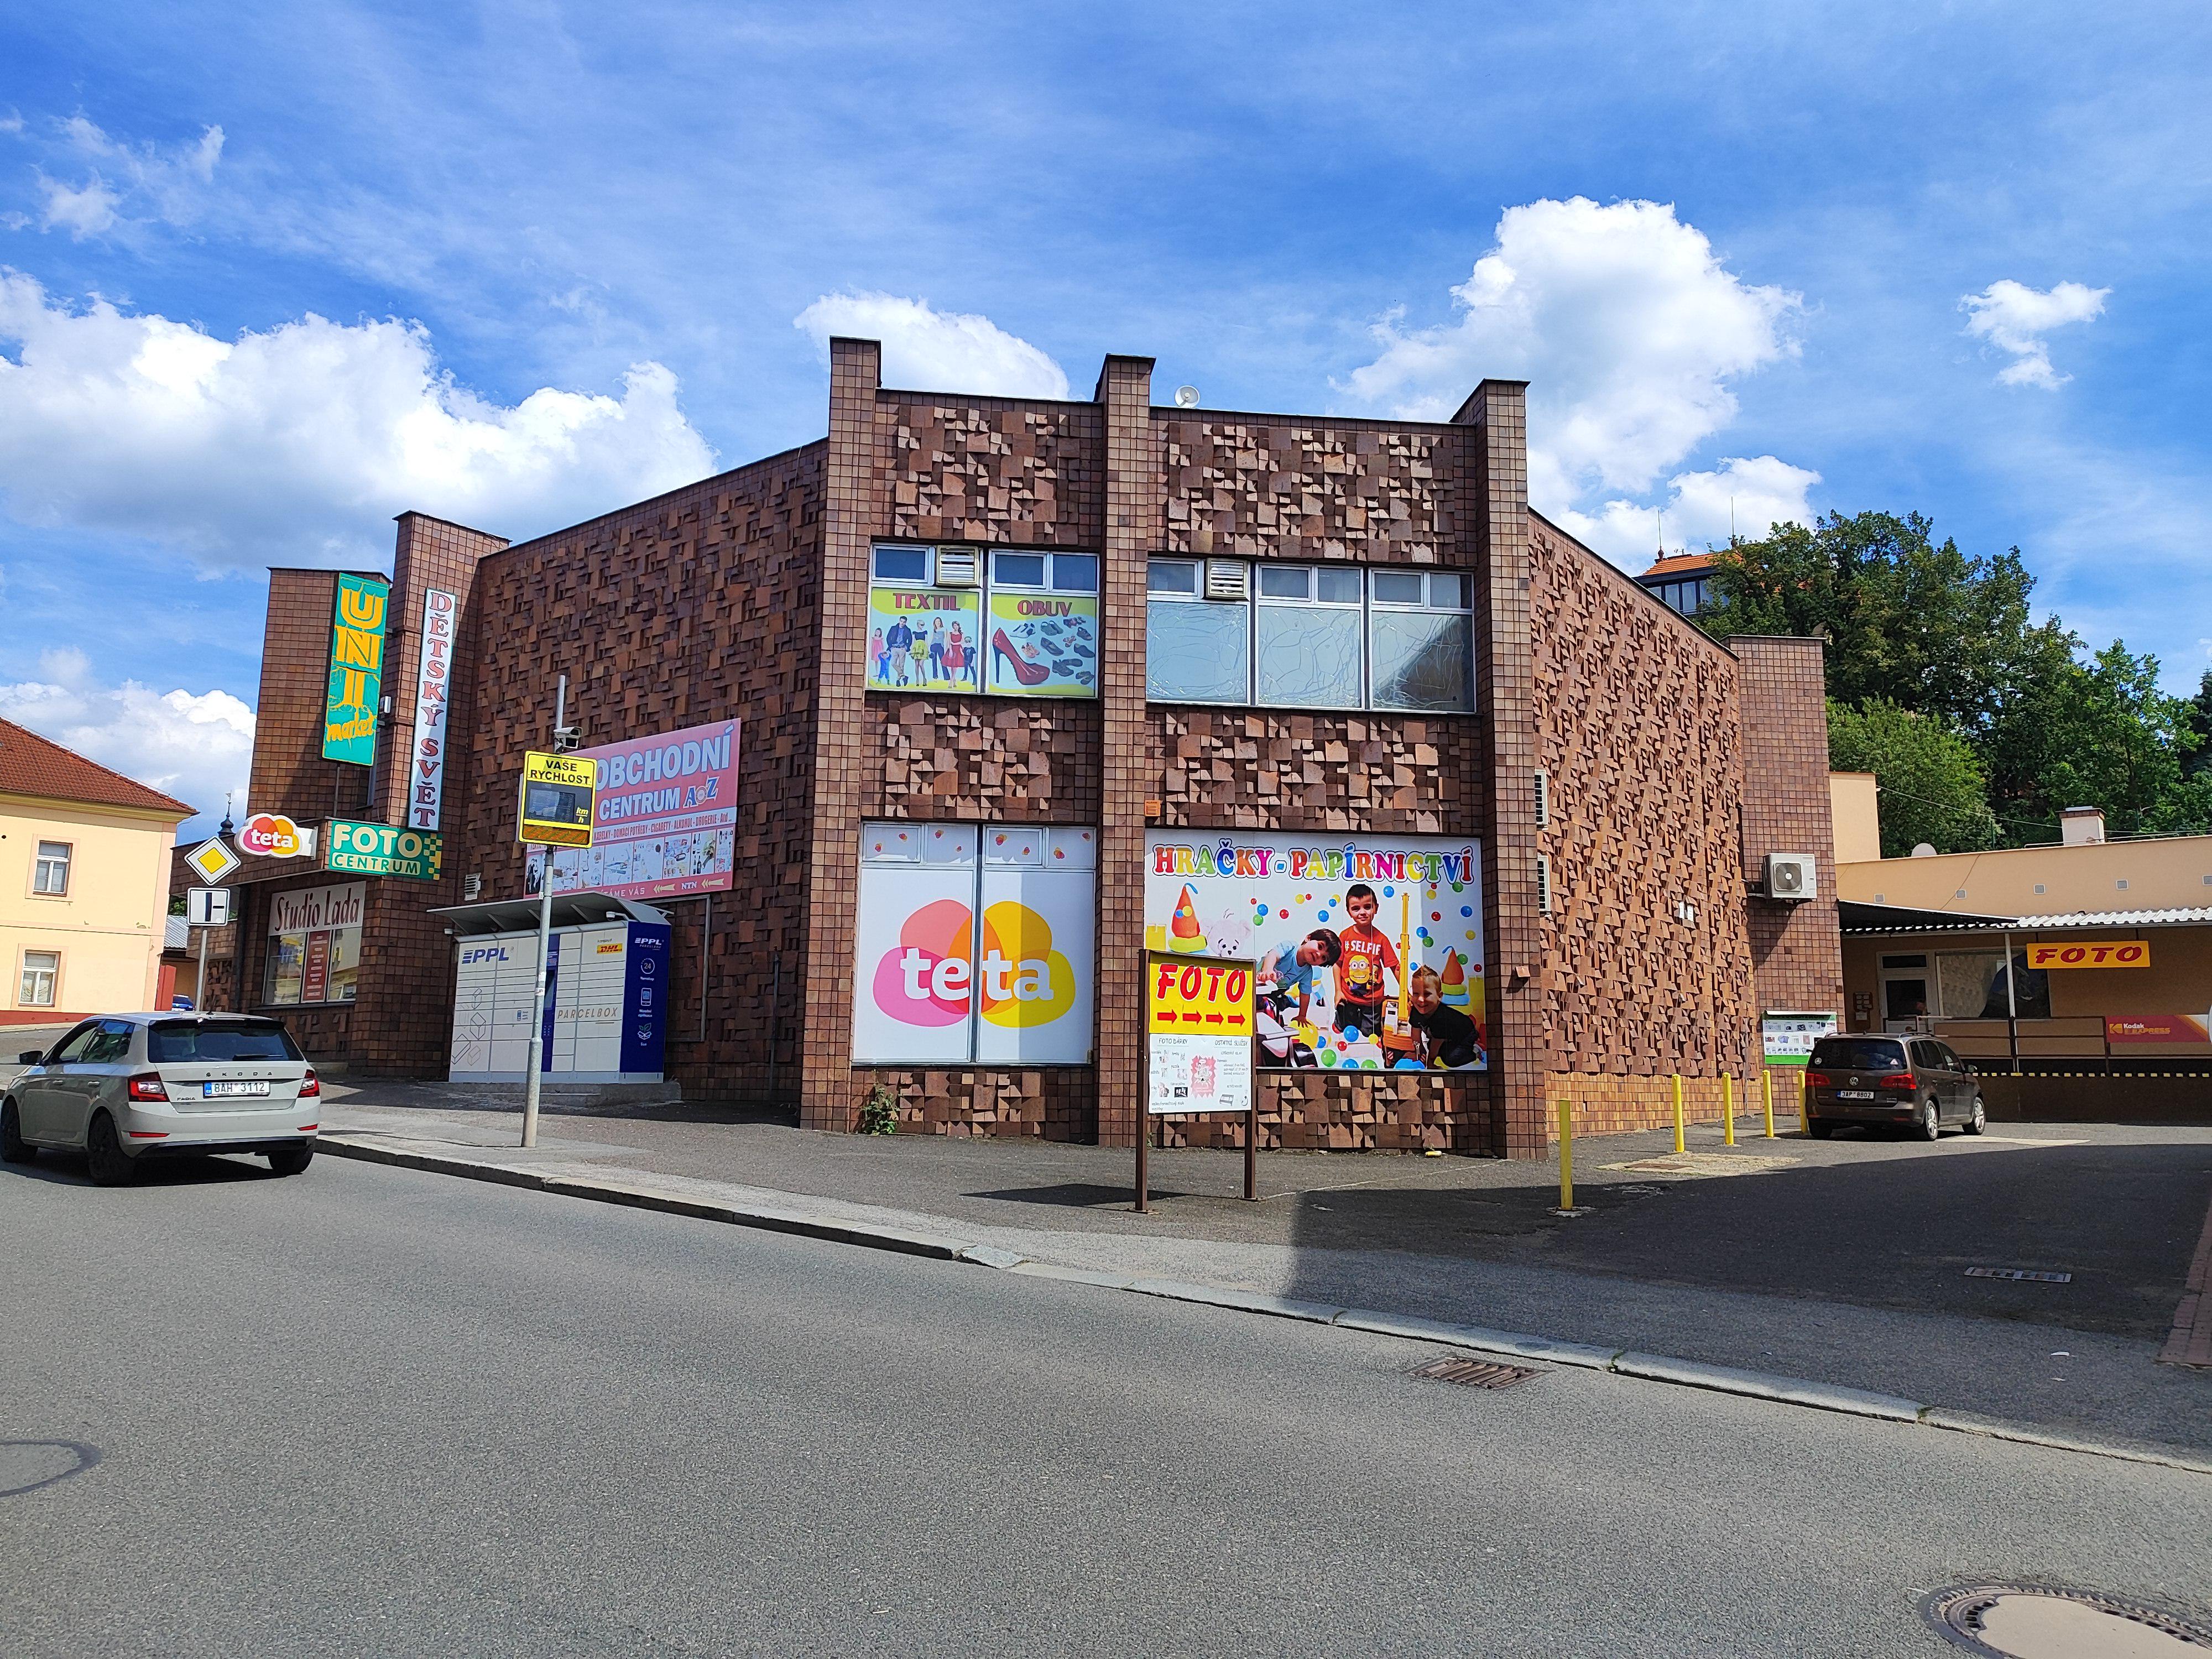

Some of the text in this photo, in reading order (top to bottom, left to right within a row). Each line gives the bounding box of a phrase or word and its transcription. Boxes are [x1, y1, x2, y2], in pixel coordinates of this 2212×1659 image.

[893, 593, 961, 611] TEXTIL
[1017, 600, 1073, 617] OBUV
[414, 591, 452, 827] DĚTSKÝ SVĚT
[325, 709, 375, 743] market
[546, 760, 577, 772] VAŠE
[596, 724, 734, 791] OBCHODNÍ
[530, 769, 590, 785] RYCHLOST
[576, 806, 588, 815] km
[599, 787, 680, 821] CENTRUM
[630, 824, 648, 836] POTŘEBY
[651, 821, 671, 833] CIGARETY
[674, 818, 692, 829] ALKOHOL
[696, 814, 717, 826] DROGERIE
[251, 828, 294, 848] teta
[333, 823, 423, 858] FOTO
[335, 854, 419, 875] CENTRUM
[1154, 839, 1274, 878] HRAČKY
[1289, 843, 1474, 884] PAPÍRNICTVÍ
[629, 886, 645, 896] VÁS
[681, 881, 697, 890] NTN
[275, 888, 360, 931] Studio Lada
[472, 947, 509, 964] PPL
[600, 945, 619, 953] DHL
[2034, 945, 2143, 964] FOTO
[899, 947, 1055, 1001] teta
[1156, 963, 1246, 1004] FOTO
[557, 1007, 618, 1019] PARCELBOX
[214, 1083, 233, 1093] 8AH
[241, 1082, 265, 1092] 3112
